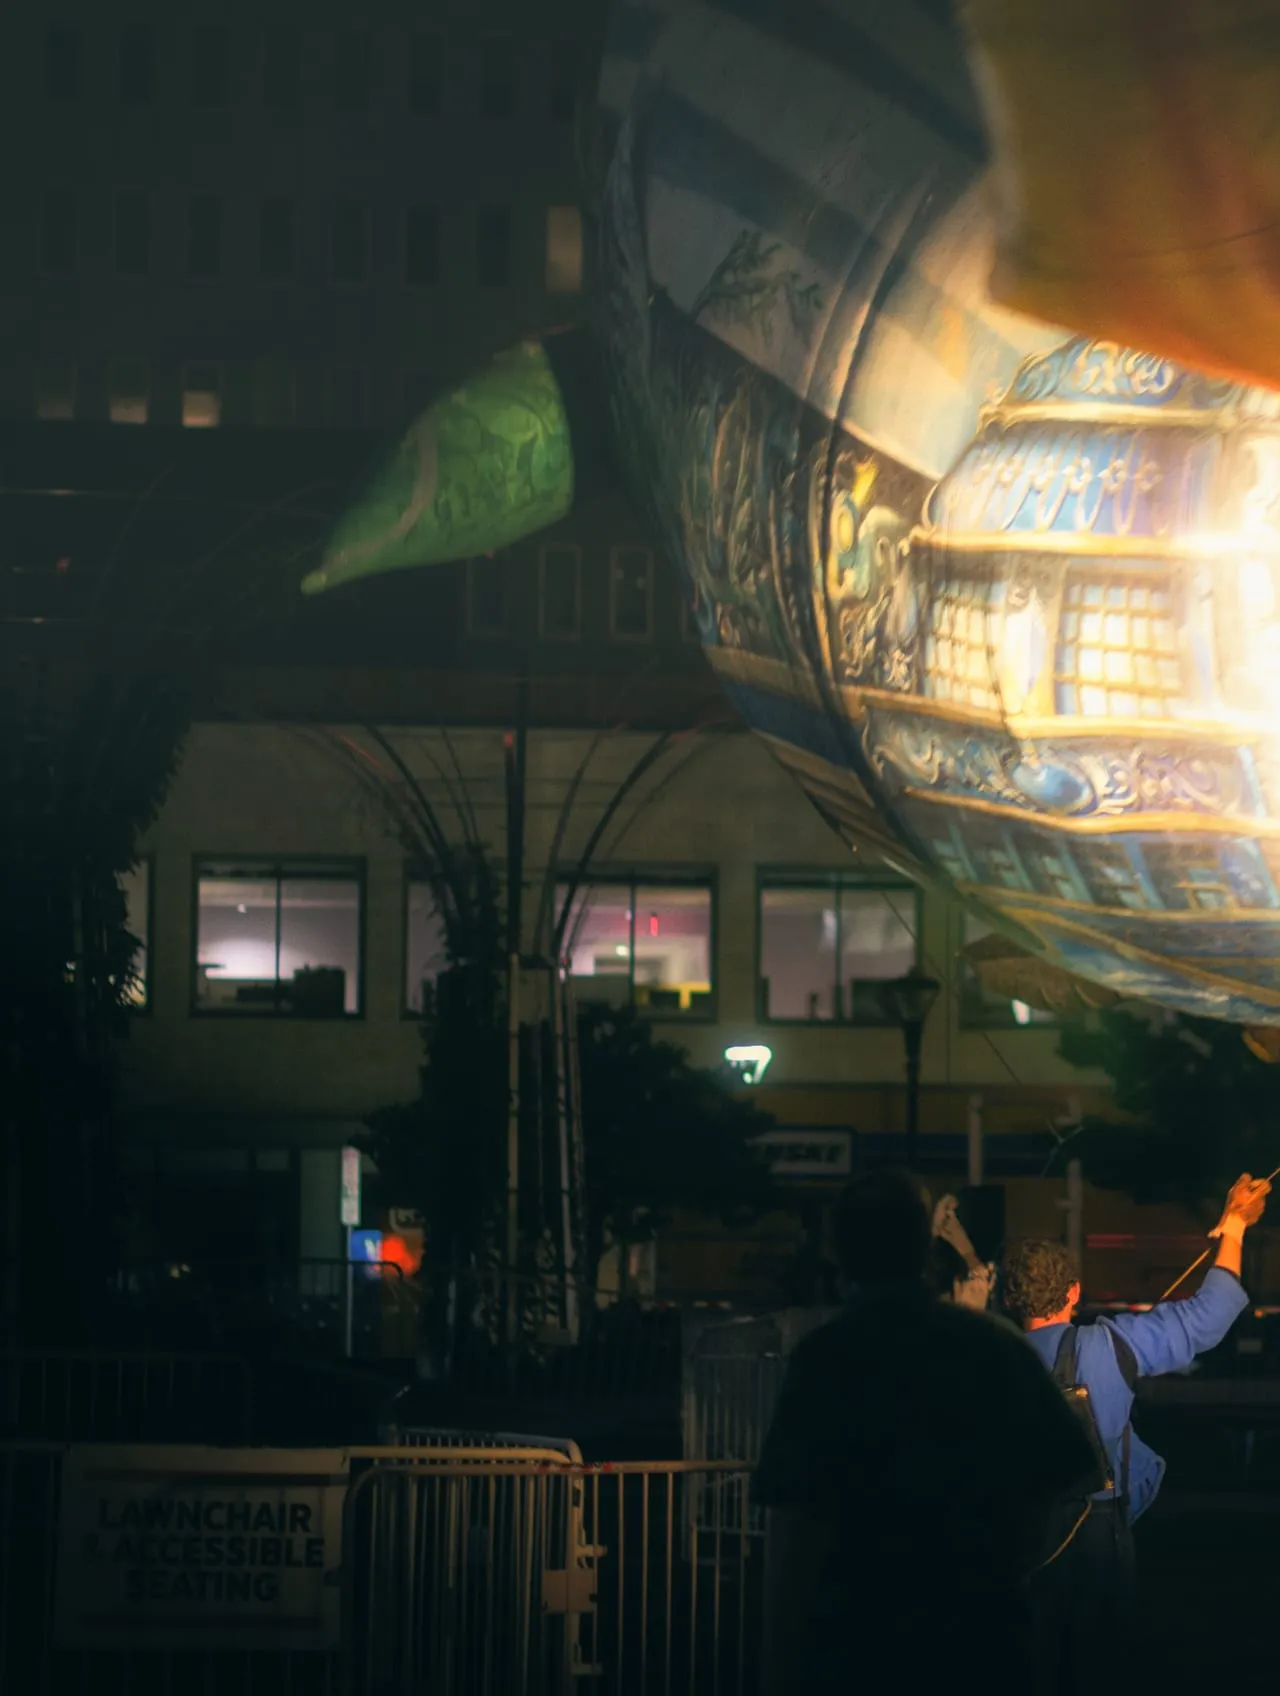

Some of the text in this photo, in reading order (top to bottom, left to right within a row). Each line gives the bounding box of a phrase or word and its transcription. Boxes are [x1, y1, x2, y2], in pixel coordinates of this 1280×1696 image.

[98, 1498, 312, 1533] LAWNCHAIR
[82, 1533, 325, 1568] & ACCESSIBLE
[125, 1571, 279, 1602] SEATING
